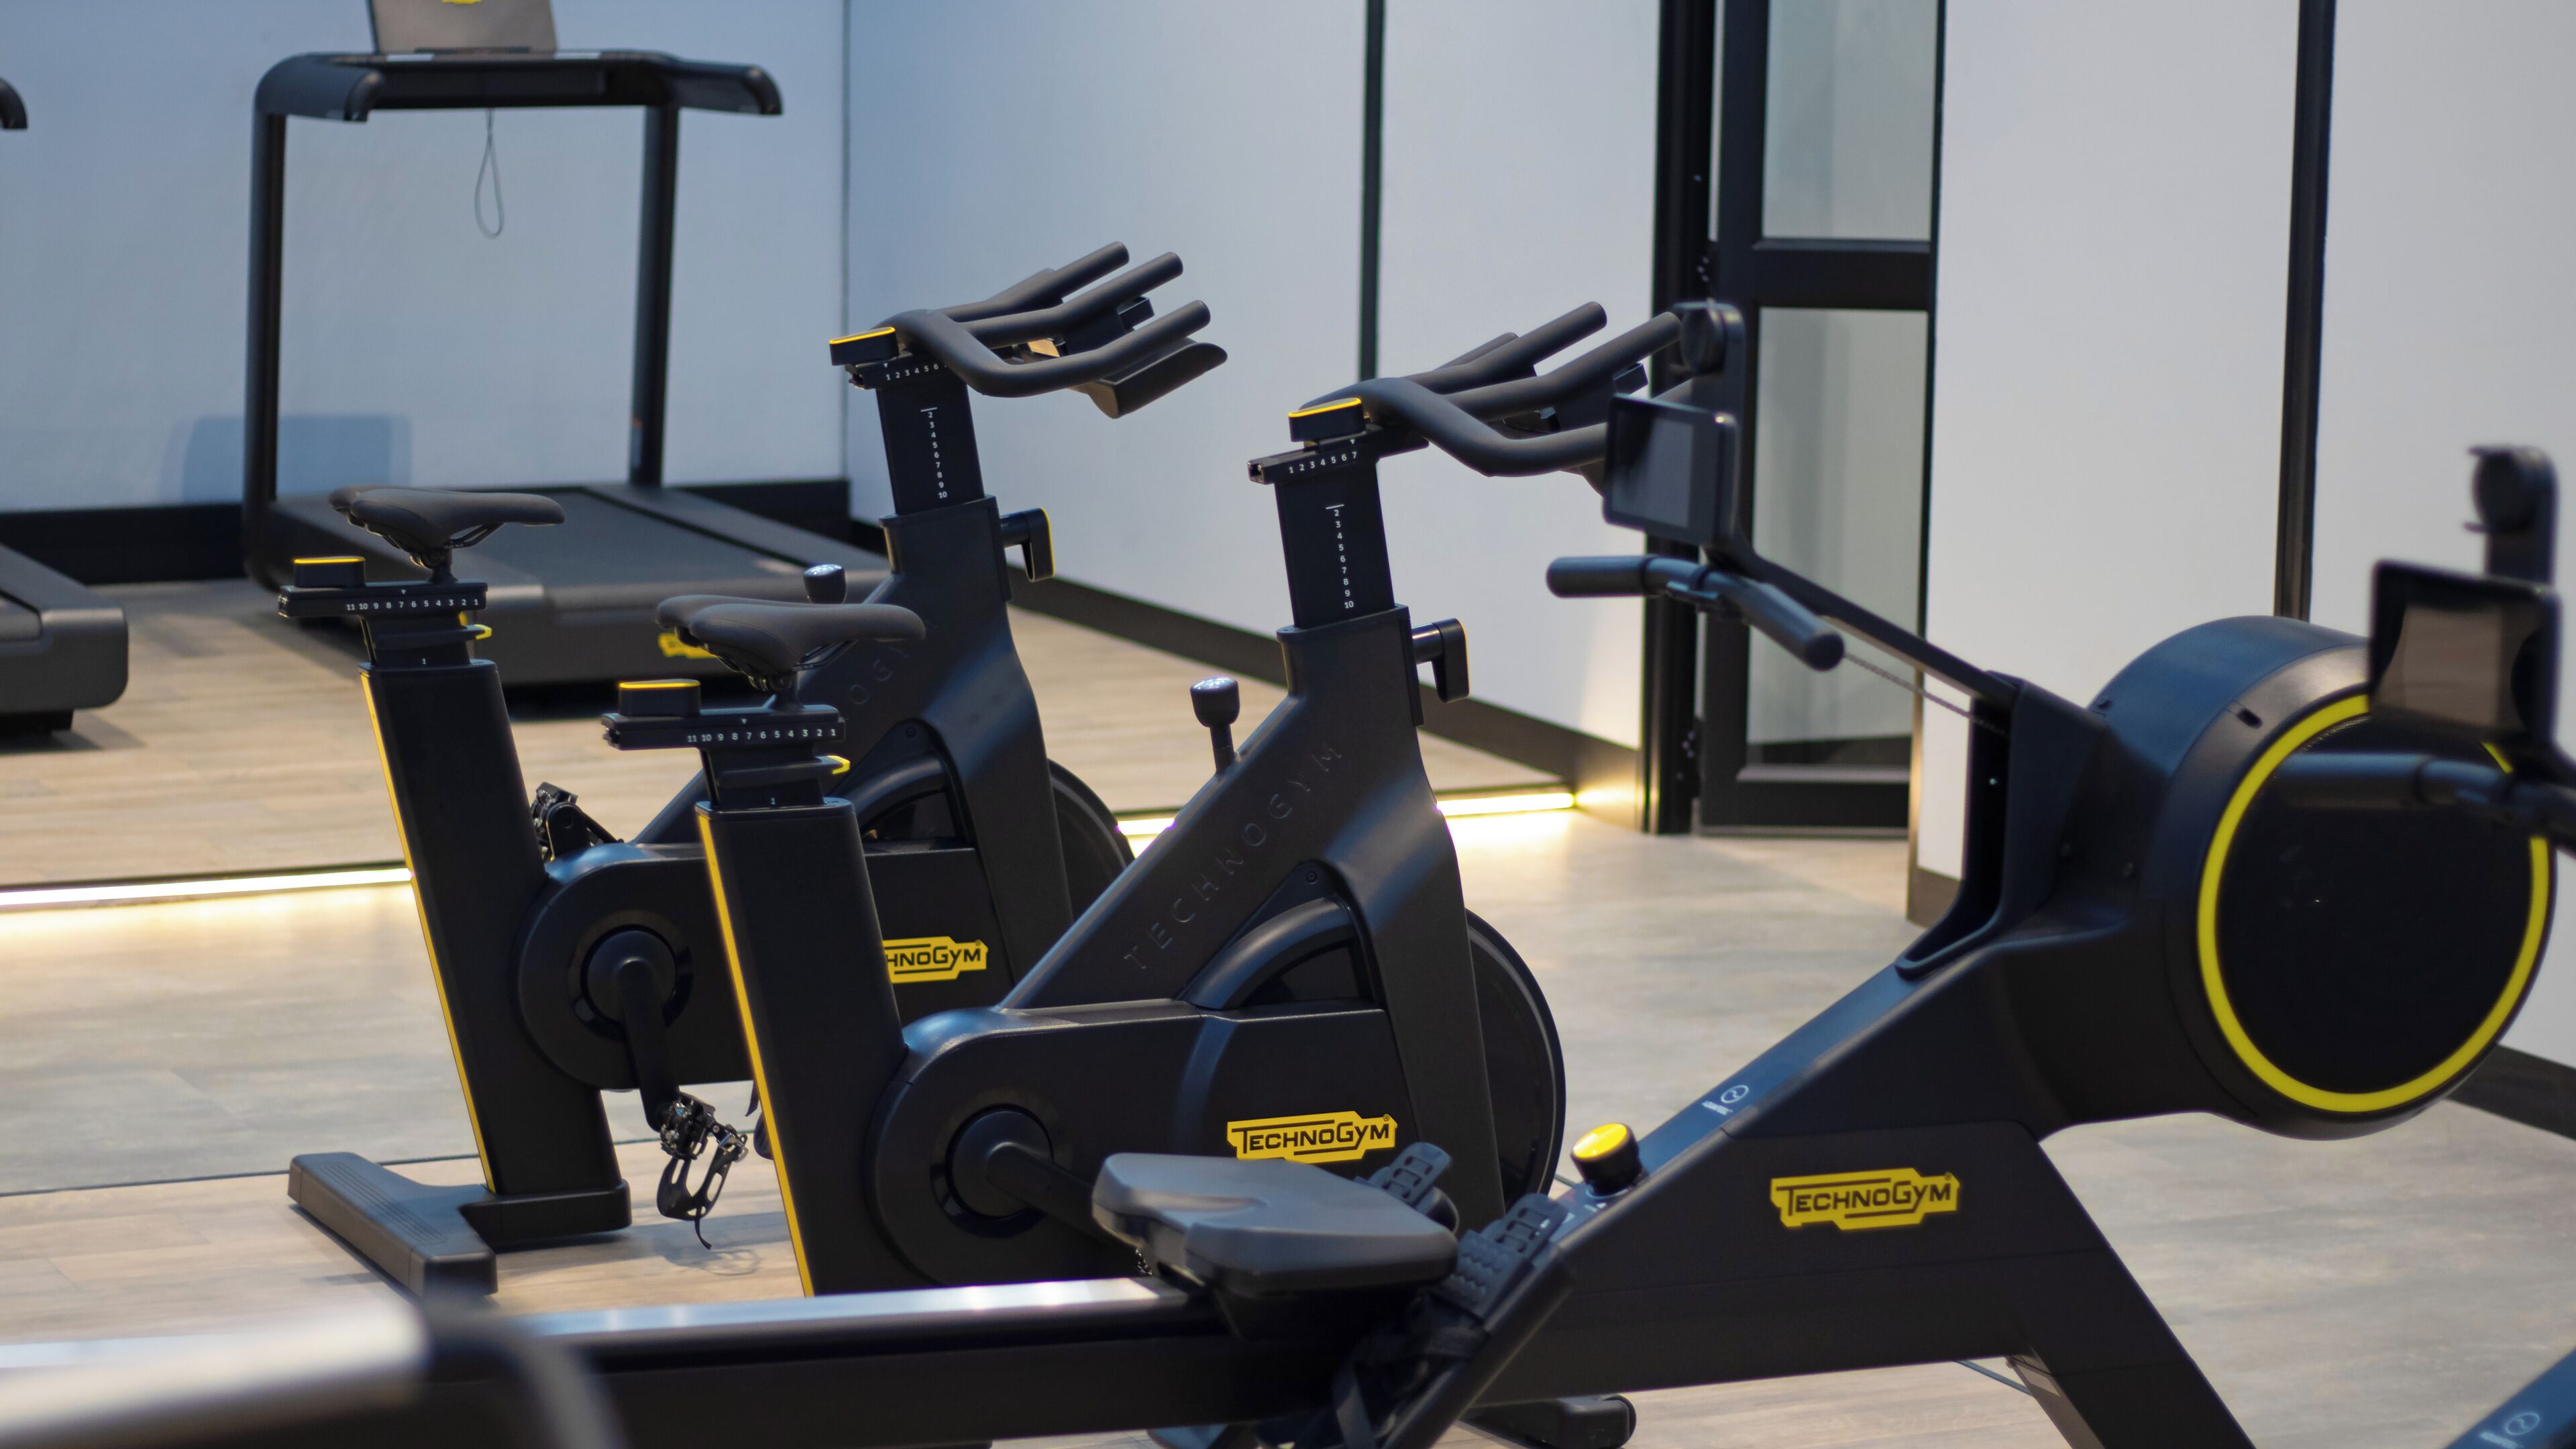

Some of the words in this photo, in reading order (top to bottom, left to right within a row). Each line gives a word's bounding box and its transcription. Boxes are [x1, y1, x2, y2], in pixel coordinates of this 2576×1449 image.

[895, 371, 901, 379] 2
[1288, 466, 1294, 474] 1
[1299, 463, 1305, 472] 2
[1309, 460, 1316, 469] 3
[1320, 458, 1326, 466] 4
[1330, 455, 1337, 464] 5
[1341, 453, 1348, 462] 6
[1352, 451, 1357, 459] 7
[936, 471, 943, 479] 8
[938, 490, 948, 499] 10
[1334, 508, 1340, 517] 2
[1335, 520, 1341, 529] 3
[1336, 531, 1343, 540] 4
[1338, 543, 1344, 552] 5
[1340, 555, 1346, 563] 6
[1341, 566, 1347, 574] 7
[1342, 578, 1350, 586] 8
[1344, 589, 1351, 597] 9
[345, 603, 356, 611] 11
[358, 602, 369, 610] 10
[373, 602, 379, 610] 9
[386, 601, 392, 609] 8
[411, 600, 417, 608] 6
[423, 600, 429, 608] 5
[448, 598, 454, 606] 3
[1344, 600, 1354, 609] 10
[687, 735, 698, 743] 11
[701, 733, 712, 742] 10
[717, 733, 724, 741] 9
[731, 732, 739, 741] 8
[746, 731, 752, 740] 7
[759, 731, 767, 739] 6
[774, 730, 781, 739] 5
[787, 729, 794, 738] 4
[802, 729, 808, 737] 3
[816, 729, 823, 737] 2
[830, 728, 837, 737] 1
[771, 797, 776, 805] 1
[1124, 741, 1342, 969] TECHNOGYM
[1232, 1120, 1389, 1156] TECHNOGYM
[1776, 1178, 1951, 1219] TECHNOGYM
